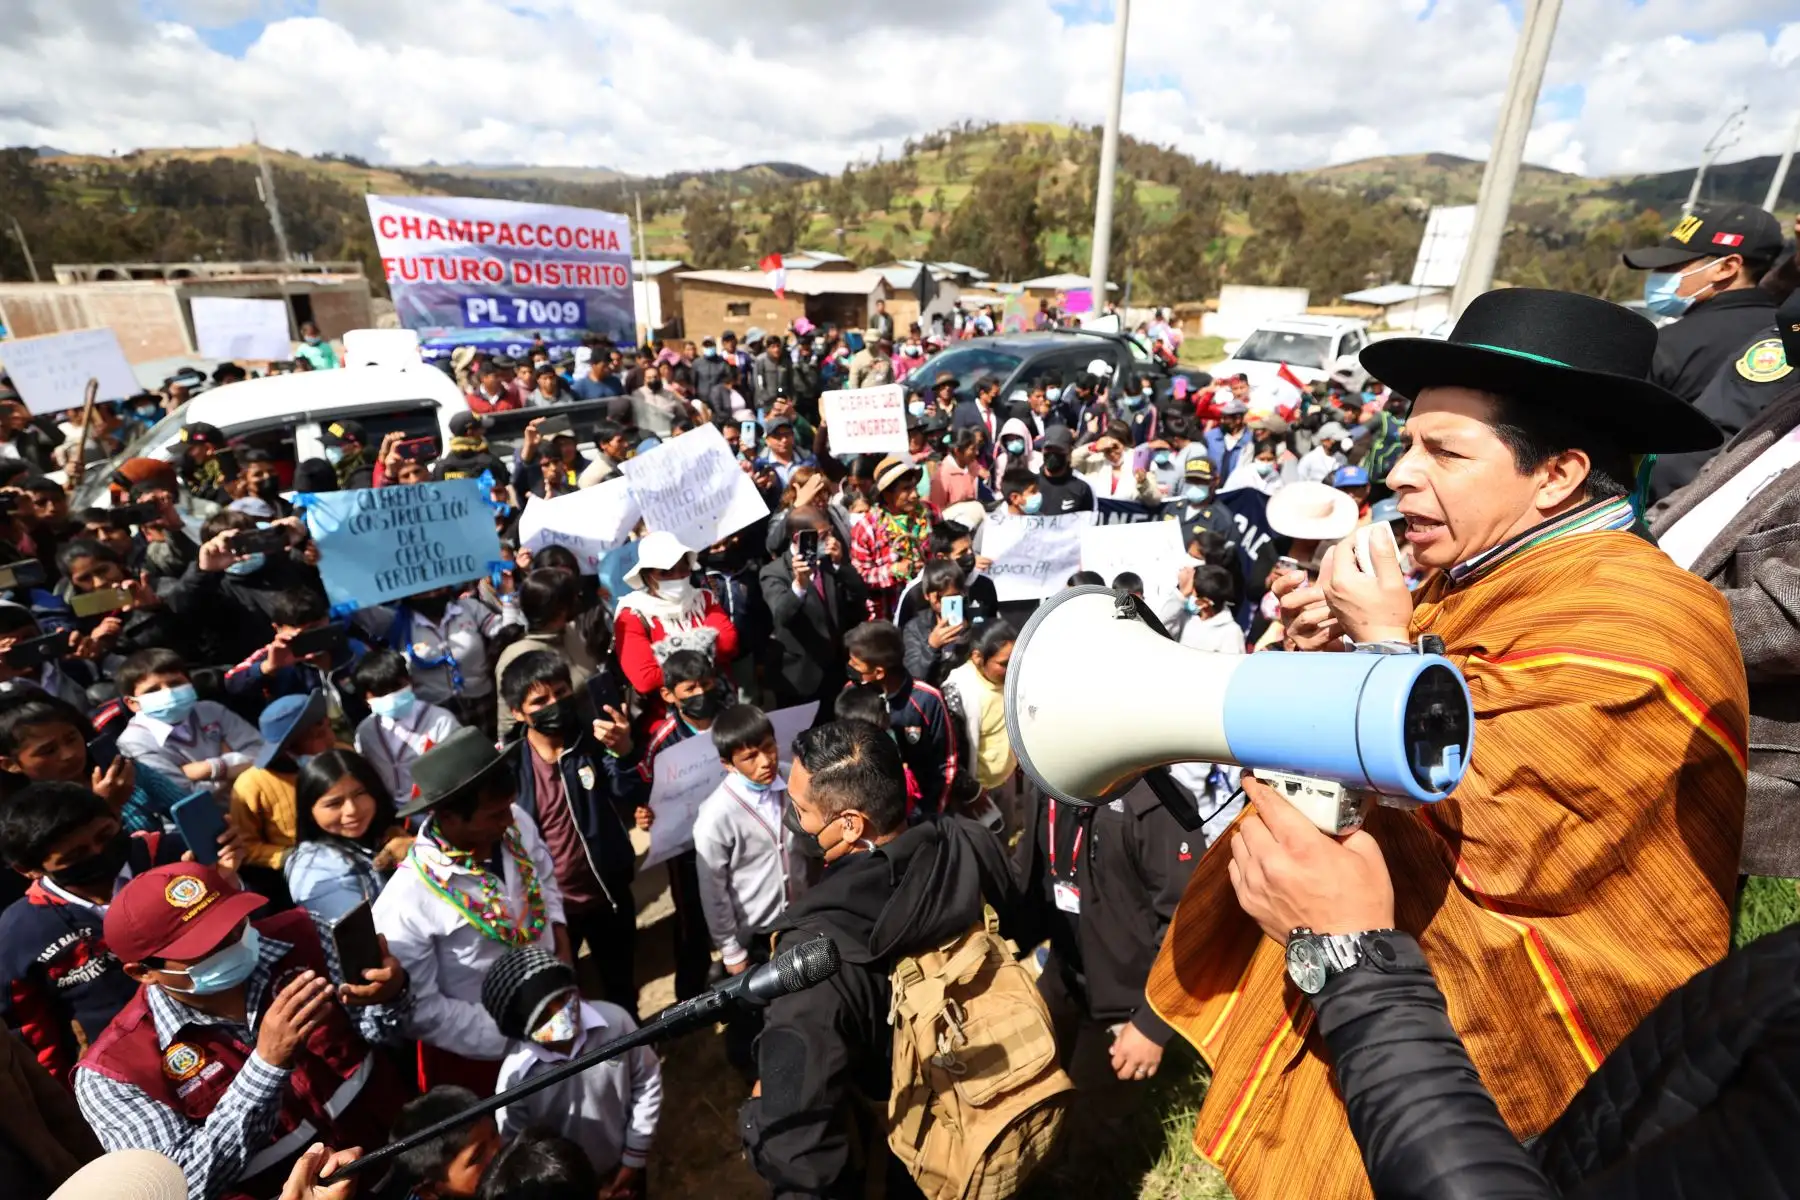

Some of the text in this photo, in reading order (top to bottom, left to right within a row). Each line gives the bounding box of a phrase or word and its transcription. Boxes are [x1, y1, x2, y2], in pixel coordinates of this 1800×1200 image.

[378, 215, 621, 251] CHAMPACCOCHA
[381, 257, 628, 287] FUTURO DISTRITO
[466, 298, 581, 325] PL 7009
[846, 418, 900, 437] CONGRESO
[357, 484, 442, 513] QUEREMOS
[396, 526, 427, 546] DEL
[394, 541, 446, 566] CERCO
